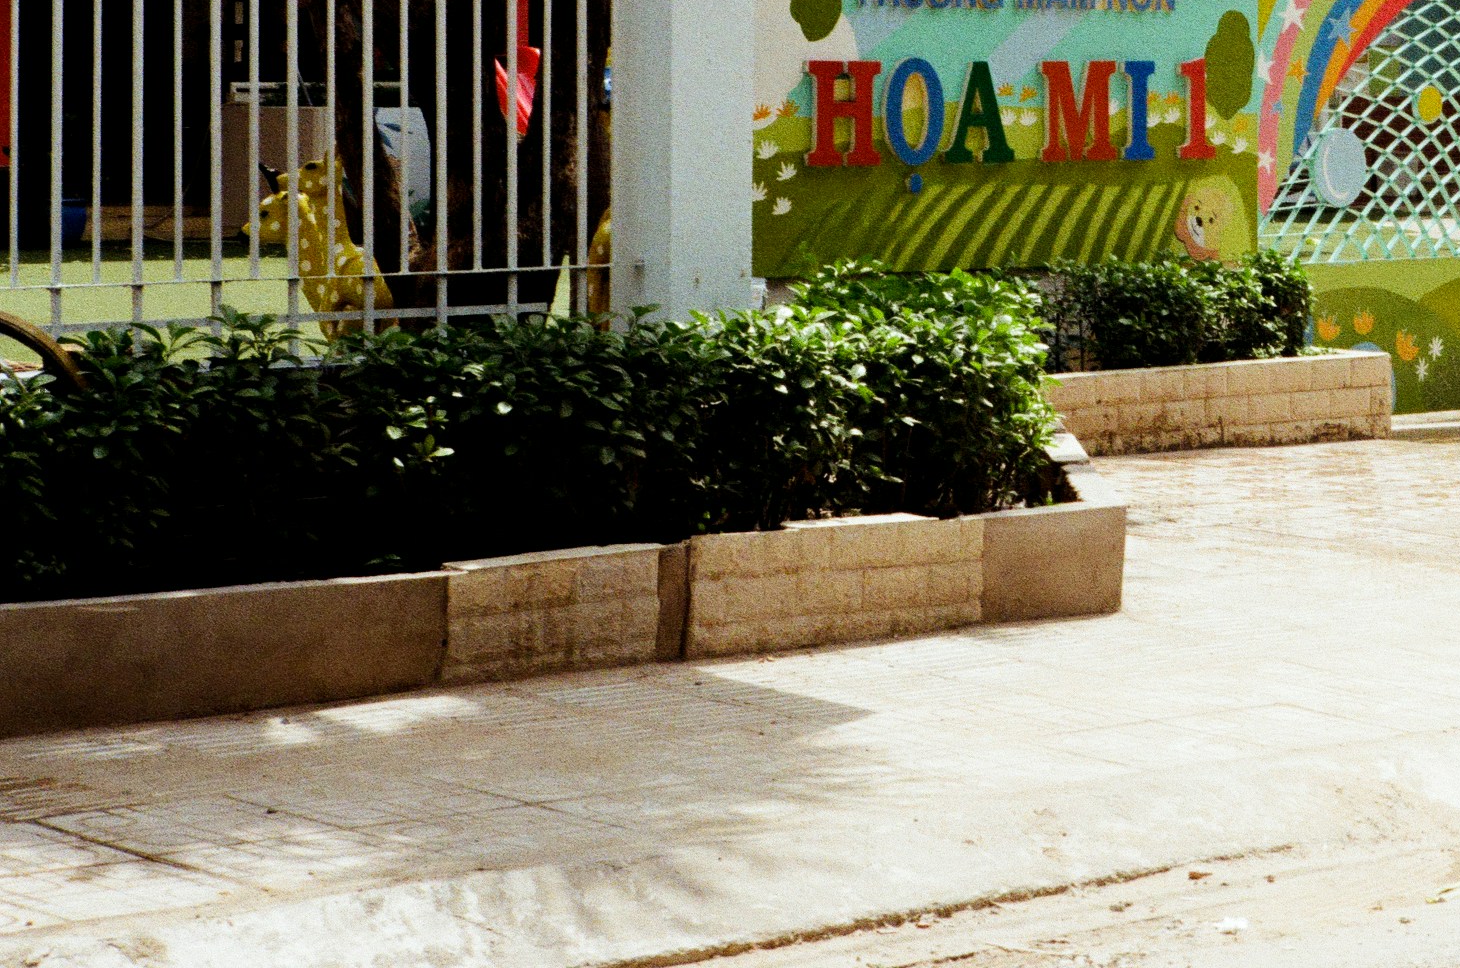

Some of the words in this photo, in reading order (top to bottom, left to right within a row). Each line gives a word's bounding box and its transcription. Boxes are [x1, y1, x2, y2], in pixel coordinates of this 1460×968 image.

[804, 57, 1016, 194] HỌA
[1038, 59, 1156, 163] MI
[1176, 58, 1217, 161] 1
